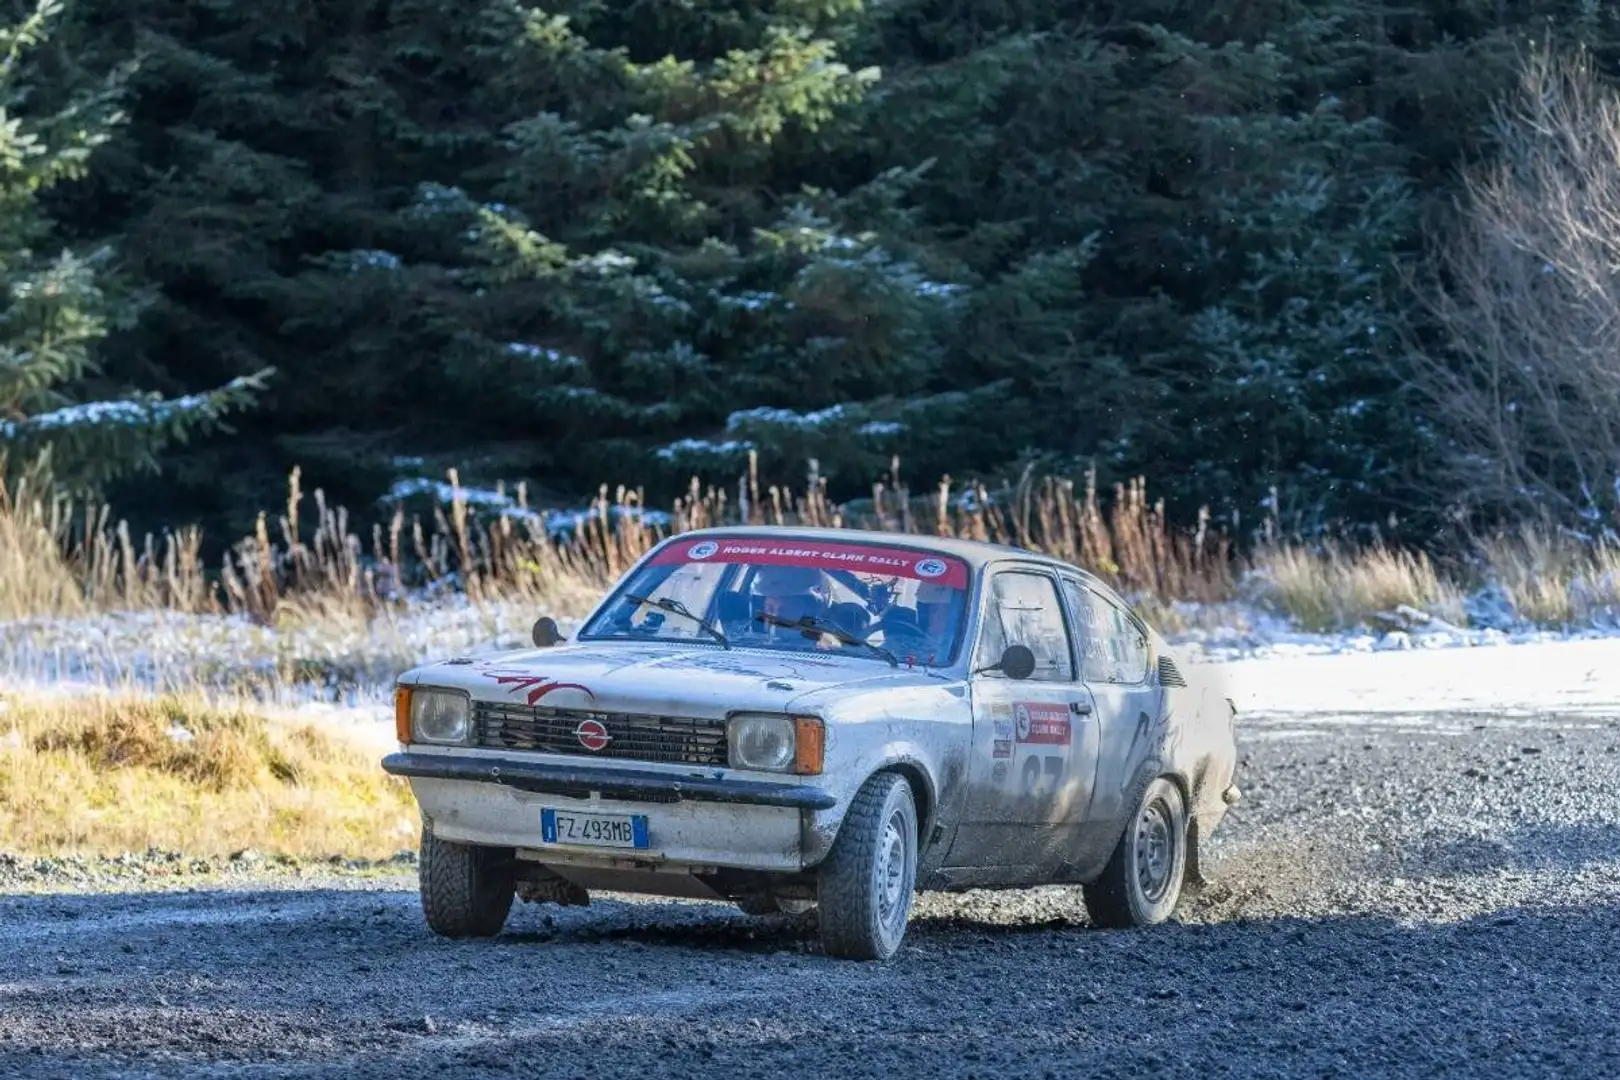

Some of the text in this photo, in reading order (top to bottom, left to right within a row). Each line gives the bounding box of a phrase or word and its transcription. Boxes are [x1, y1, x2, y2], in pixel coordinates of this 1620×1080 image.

[723, 546, 909, 567] ROGER ALBERT CLARK RALLY
